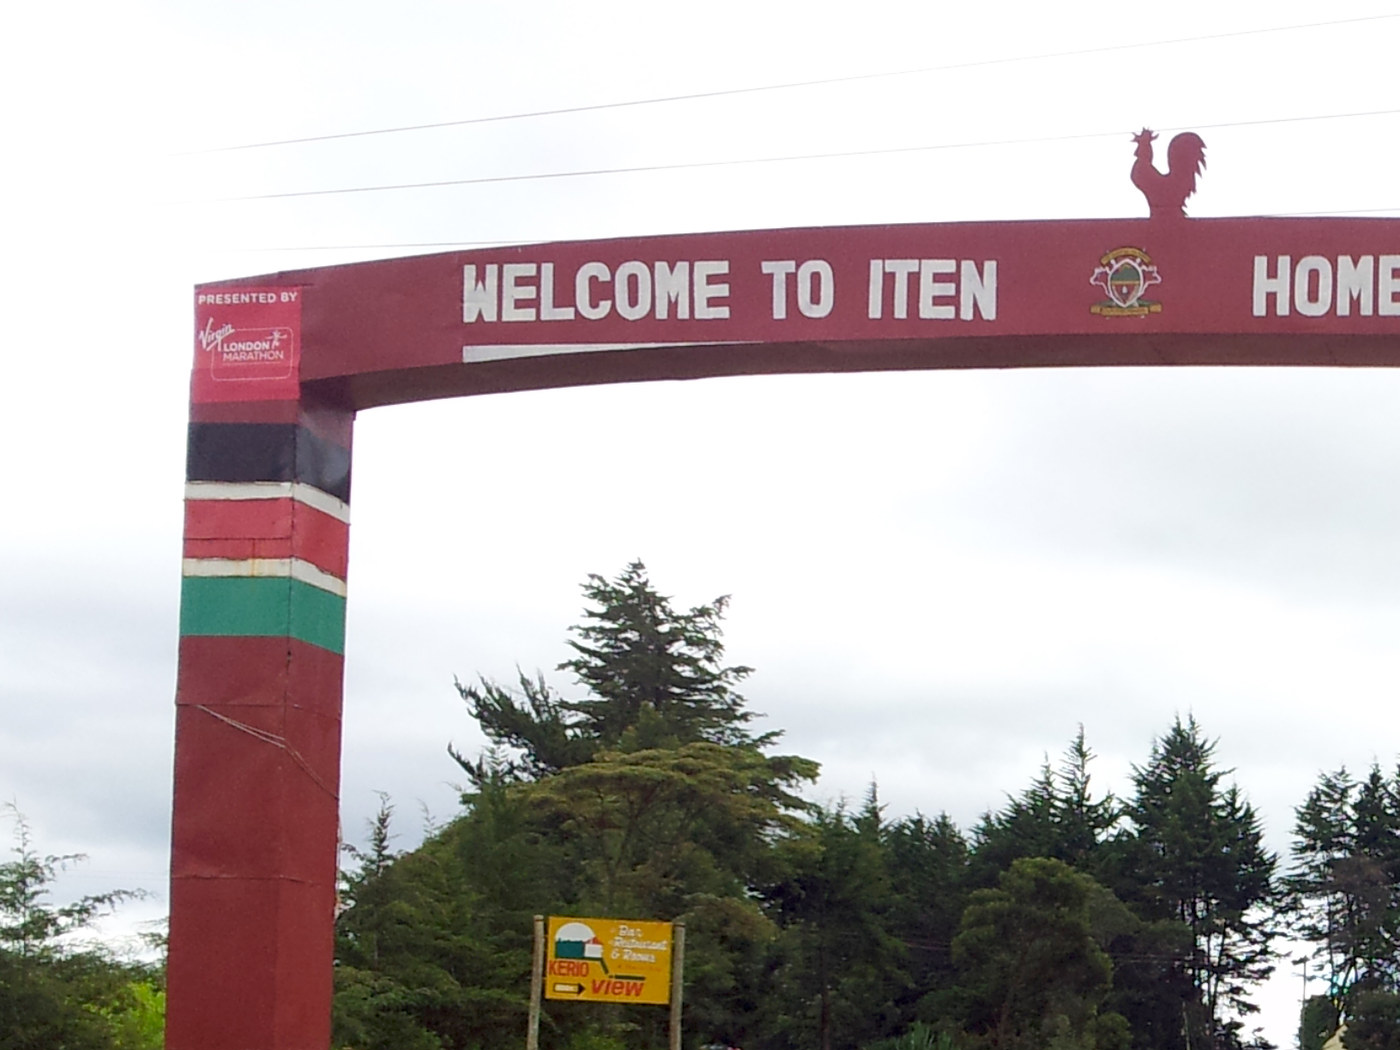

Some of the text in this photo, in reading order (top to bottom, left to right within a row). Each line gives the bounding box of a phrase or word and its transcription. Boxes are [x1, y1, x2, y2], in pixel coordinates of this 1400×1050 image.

[463, 258, 998, 323] WELCOME TO ITEN
[198, 291, 299, 305] PRESENTED BY
[199, 316, 236, 352] Virgin
[223, 340, 270, 352] LONDON
[223, 350, 284, 361] MARATHON
[619, 924, 643, 937] Bar
[548, 960, 589, 977] KERIO
